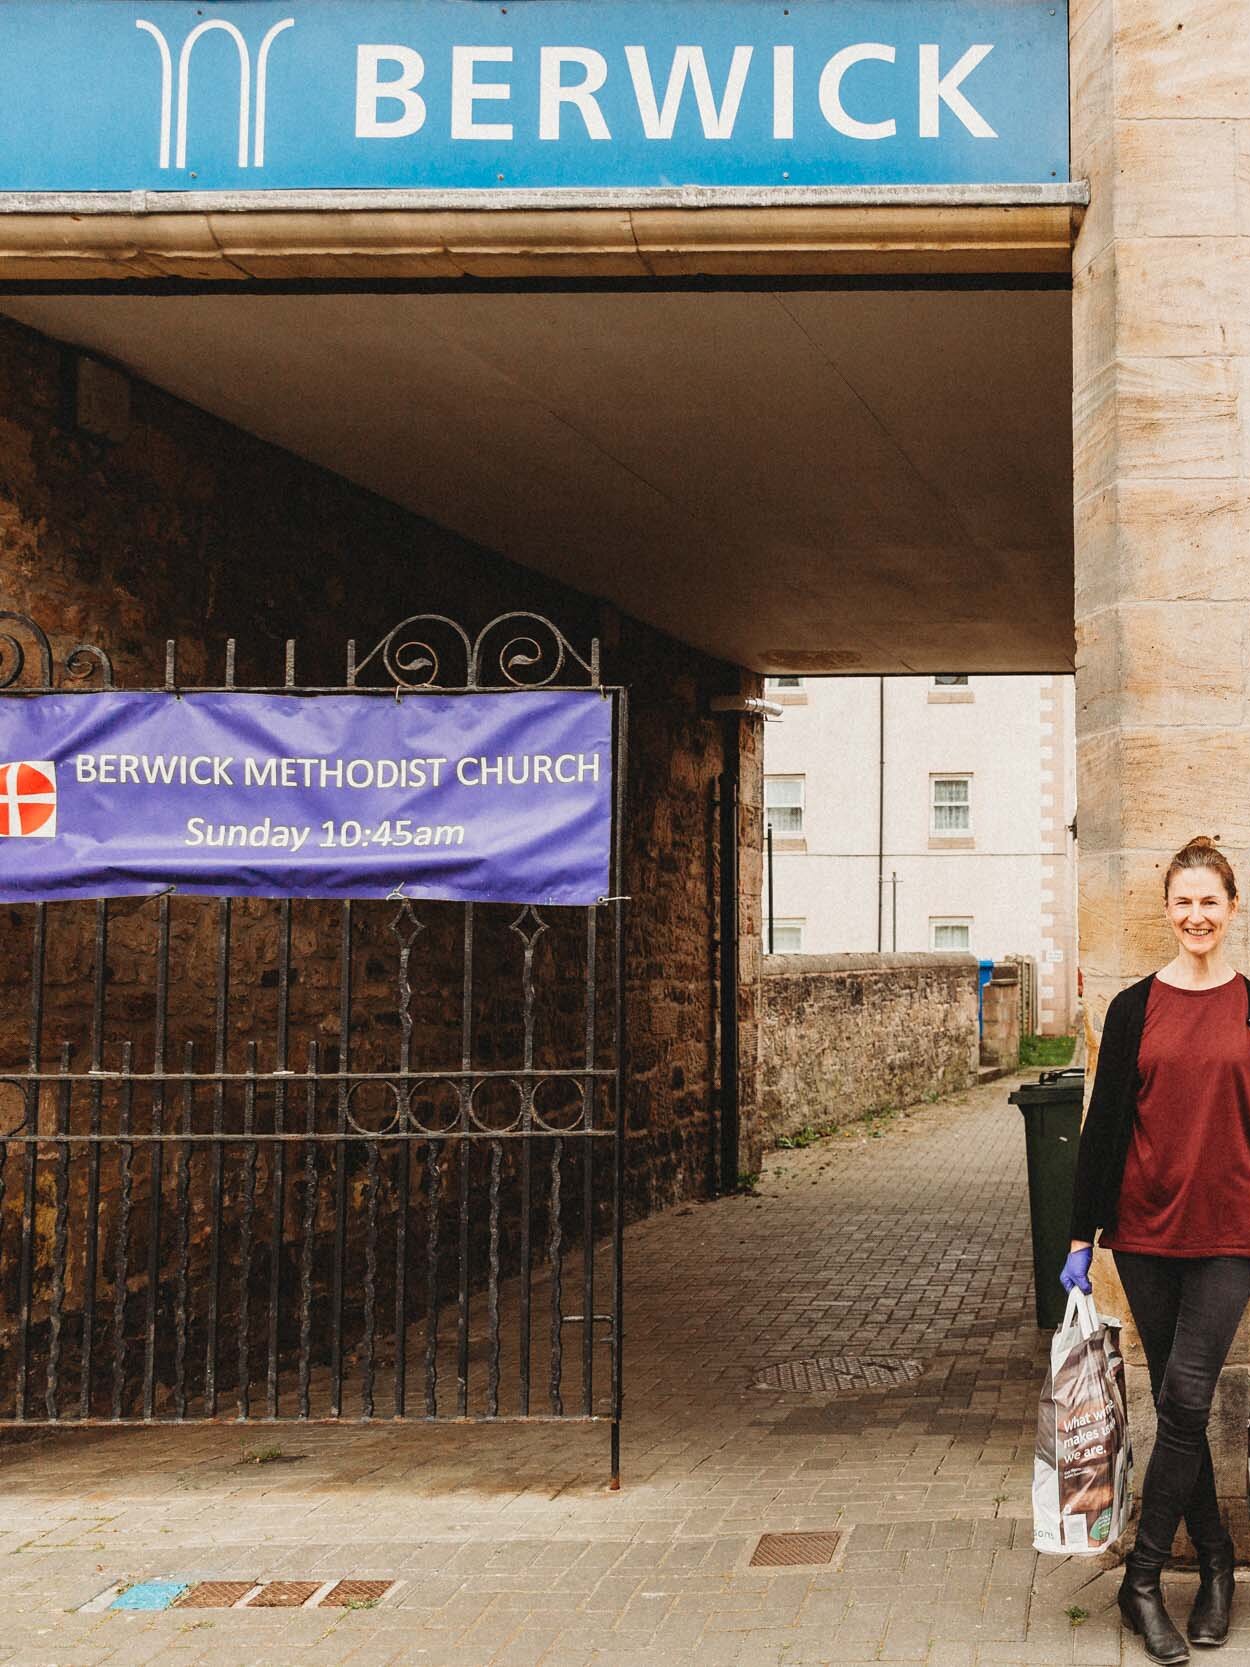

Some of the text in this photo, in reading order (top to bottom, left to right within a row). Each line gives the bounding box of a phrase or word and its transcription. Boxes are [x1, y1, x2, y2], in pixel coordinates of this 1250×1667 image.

[355, 43, 999, 141] BERWICK
[76, 753, 601, 789] BERWICK METHODIST CHURCH
[184, 817, 466, 853] Sunday 10:45am
[1064, 1413, 1091, 1433] What
[1063, 1430, 1099, 1450] makes
[1064, 1444, 1107, 1464] we are.
